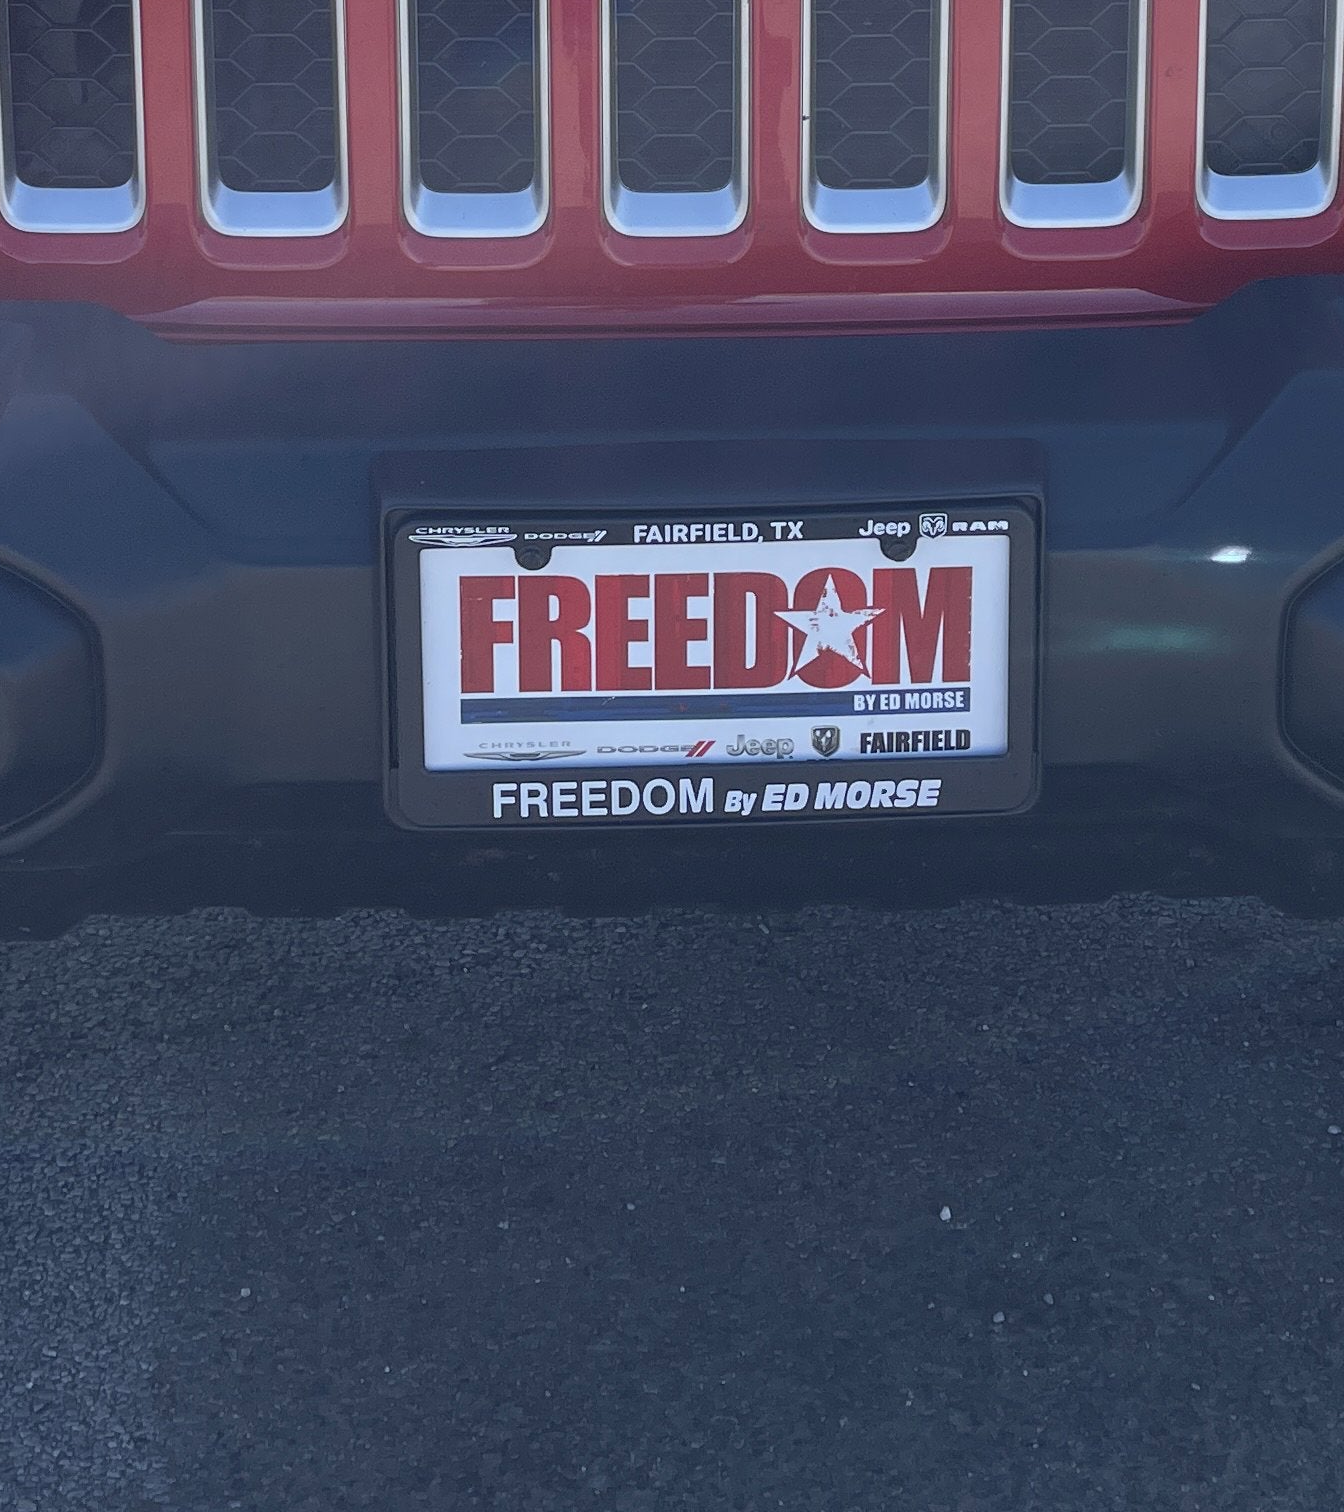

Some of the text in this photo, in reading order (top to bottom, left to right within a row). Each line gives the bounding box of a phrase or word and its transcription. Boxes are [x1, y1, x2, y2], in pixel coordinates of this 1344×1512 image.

[415, 526, 510, 535] CHRYSLER
[633, 520, 804, 544] FAIRFIELD, TX
[859, 519, 912, 538] Jeep
[952, 520, 1009, 532] RAM
[524, 532, 596, 540] DODGE
[459, 566, 974, 694] FREEDOM
[853, 691, 965, 711] BY ED MORSE
[478, 740, 572, 749] CHRYSLER
[597, 745, 696, 754] DODGE
[726, 734, 794, 760] Jeep
[860, 729, 971, 754] FAIRFIELD
[493, 778, 942, 819] FREEDOM By ED MORSE
